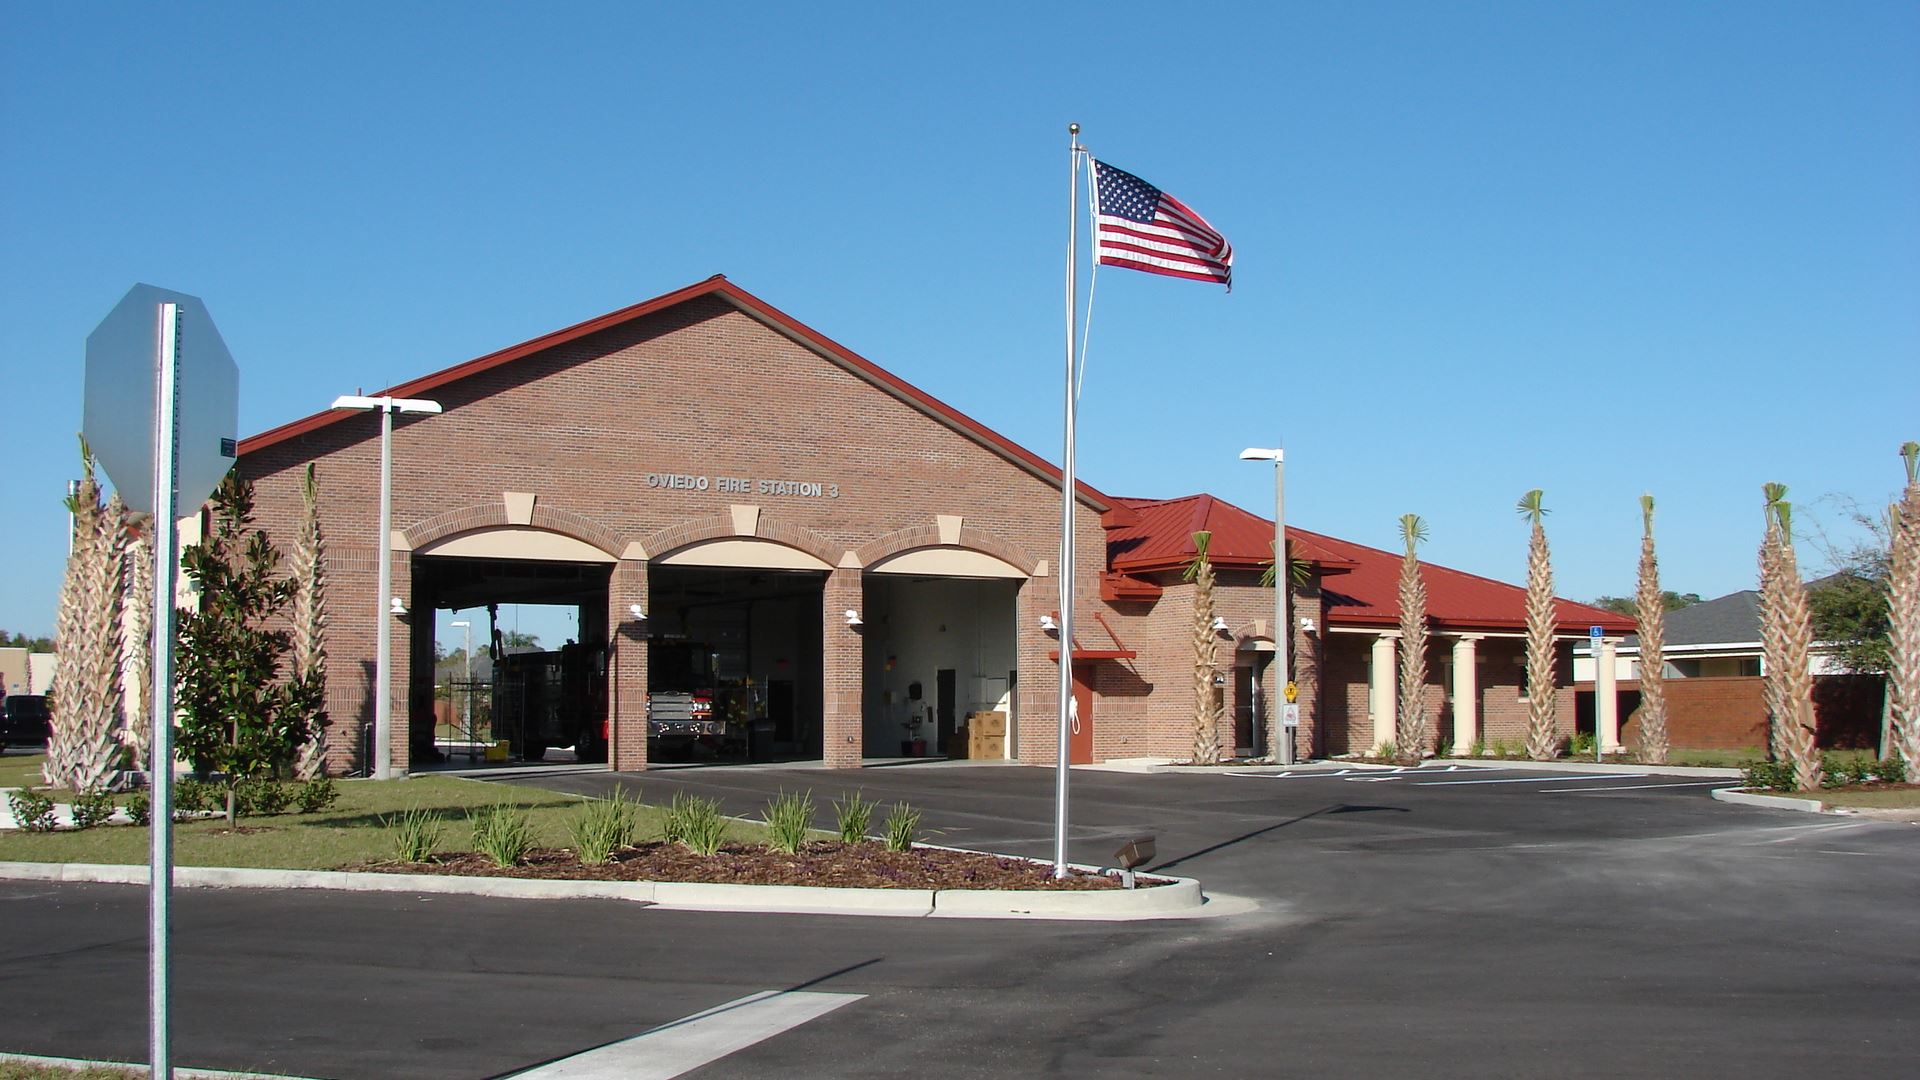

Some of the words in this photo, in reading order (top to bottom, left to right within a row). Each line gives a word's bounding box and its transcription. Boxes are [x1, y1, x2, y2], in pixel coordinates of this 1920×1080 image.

[647, 473, 709, 491] OVIEDO
[716, 477, 751, 493] FIRE
[759, 480, 822, 497] STATION
[829, 483, 840, 498] 3
